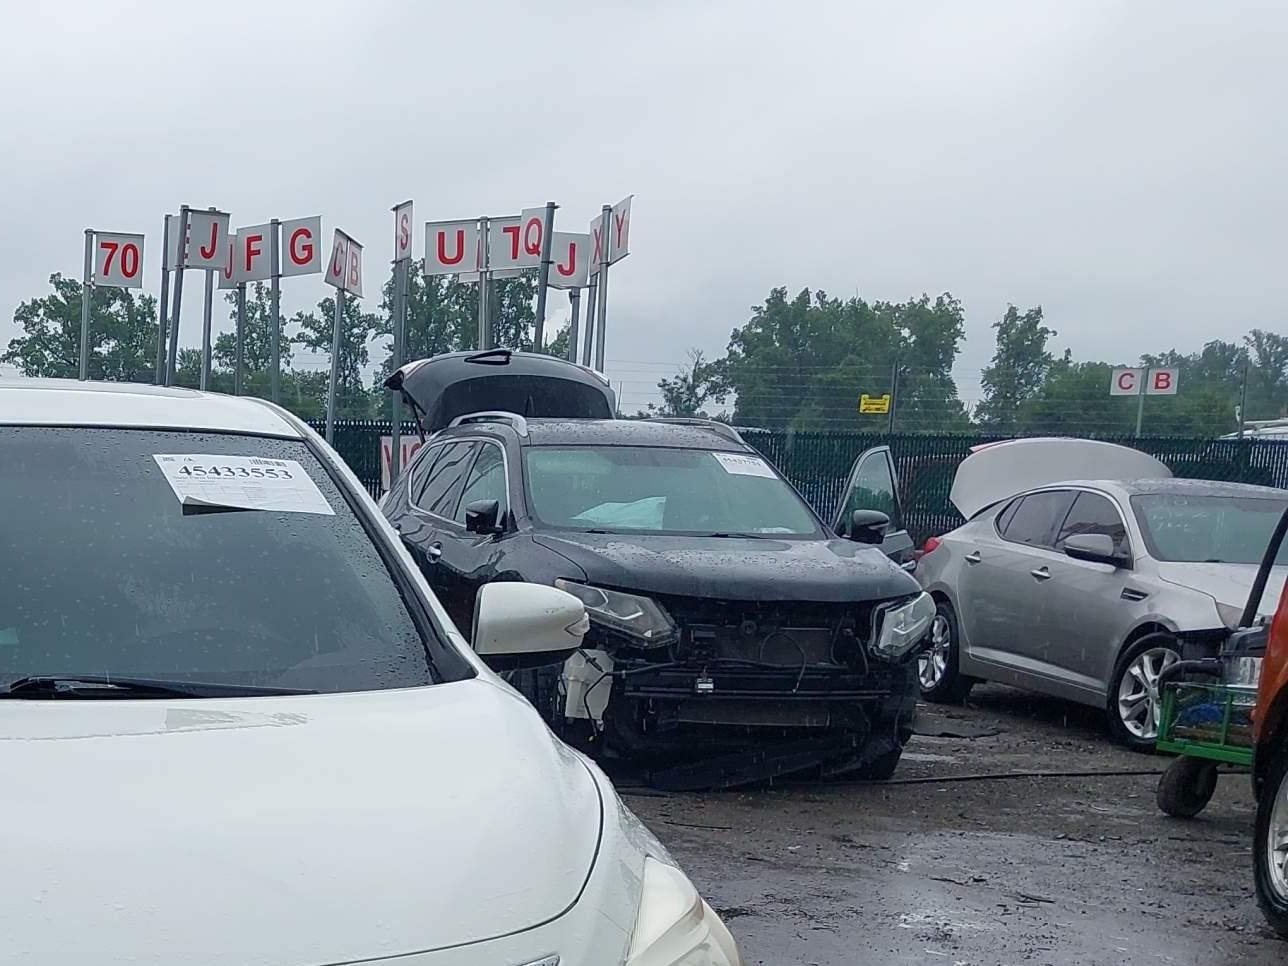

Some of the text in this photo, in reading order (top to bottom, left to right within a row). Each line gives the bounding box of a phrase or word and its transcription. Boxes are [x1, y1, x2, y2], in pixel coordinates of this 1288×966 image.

[200, 222, 219, 259] J
[289, 227, 314, 266] G
[399, 213, 409, 251] S
[524, 217, 543, 257] Q
[615, 209, 626, 249] Y
[100, 241, 140, 279] 70
[246, 234, 263, 271] F
[333, 241, 344, 277] C
[437, 230, 465, 265] U
[557, 243, 576, 276] J
[351, 252, 359, 286] B
[1117, 372, 1135, 390] C
[1154, 372, 1171, 390] B
[178, 465, 293, 480] 45433553
